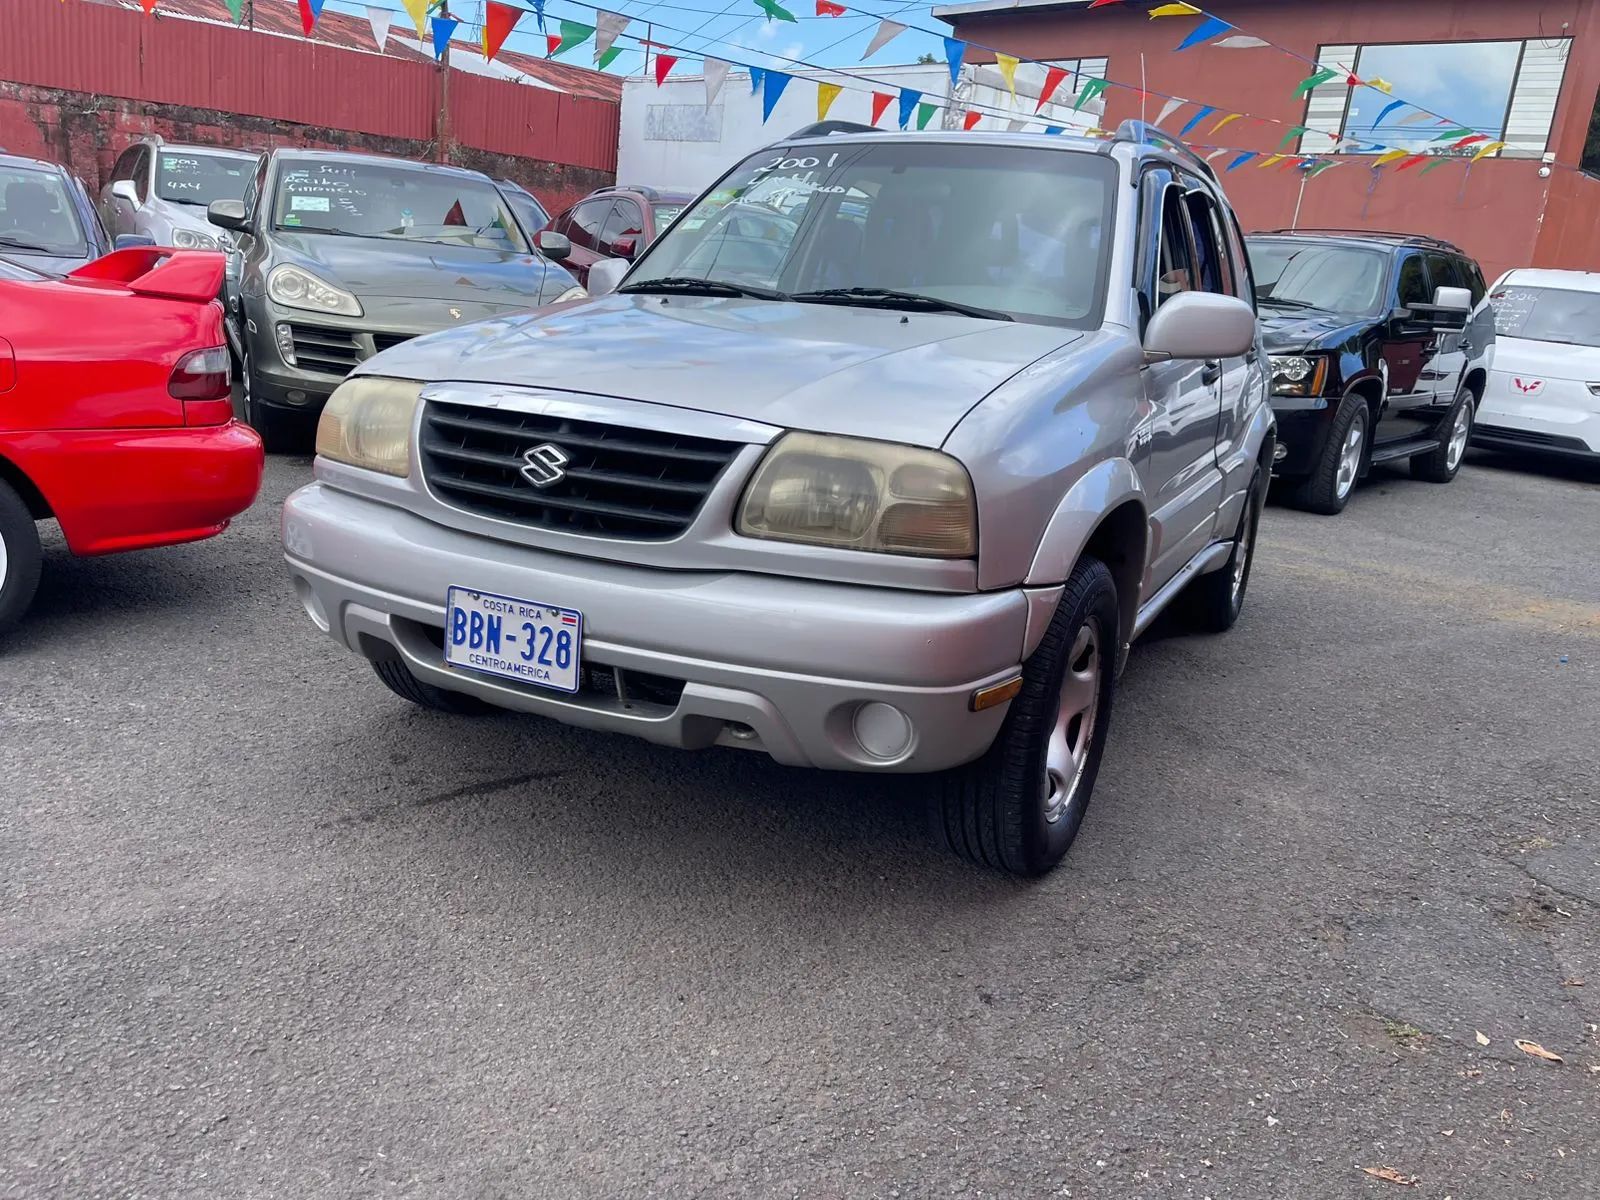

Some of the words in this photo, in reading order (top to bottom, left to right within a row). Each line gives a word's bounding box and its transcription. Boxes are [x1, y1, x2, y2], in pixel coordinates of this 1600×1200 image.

[753, 153, 839, 173] 2001
[483, 599, 515, 615] COSTA
[519, 606, 542, 620] RICA
[452, 606, 571, 670] BBN-328
[469, 653, 551, 680] CENTROAMERICA
